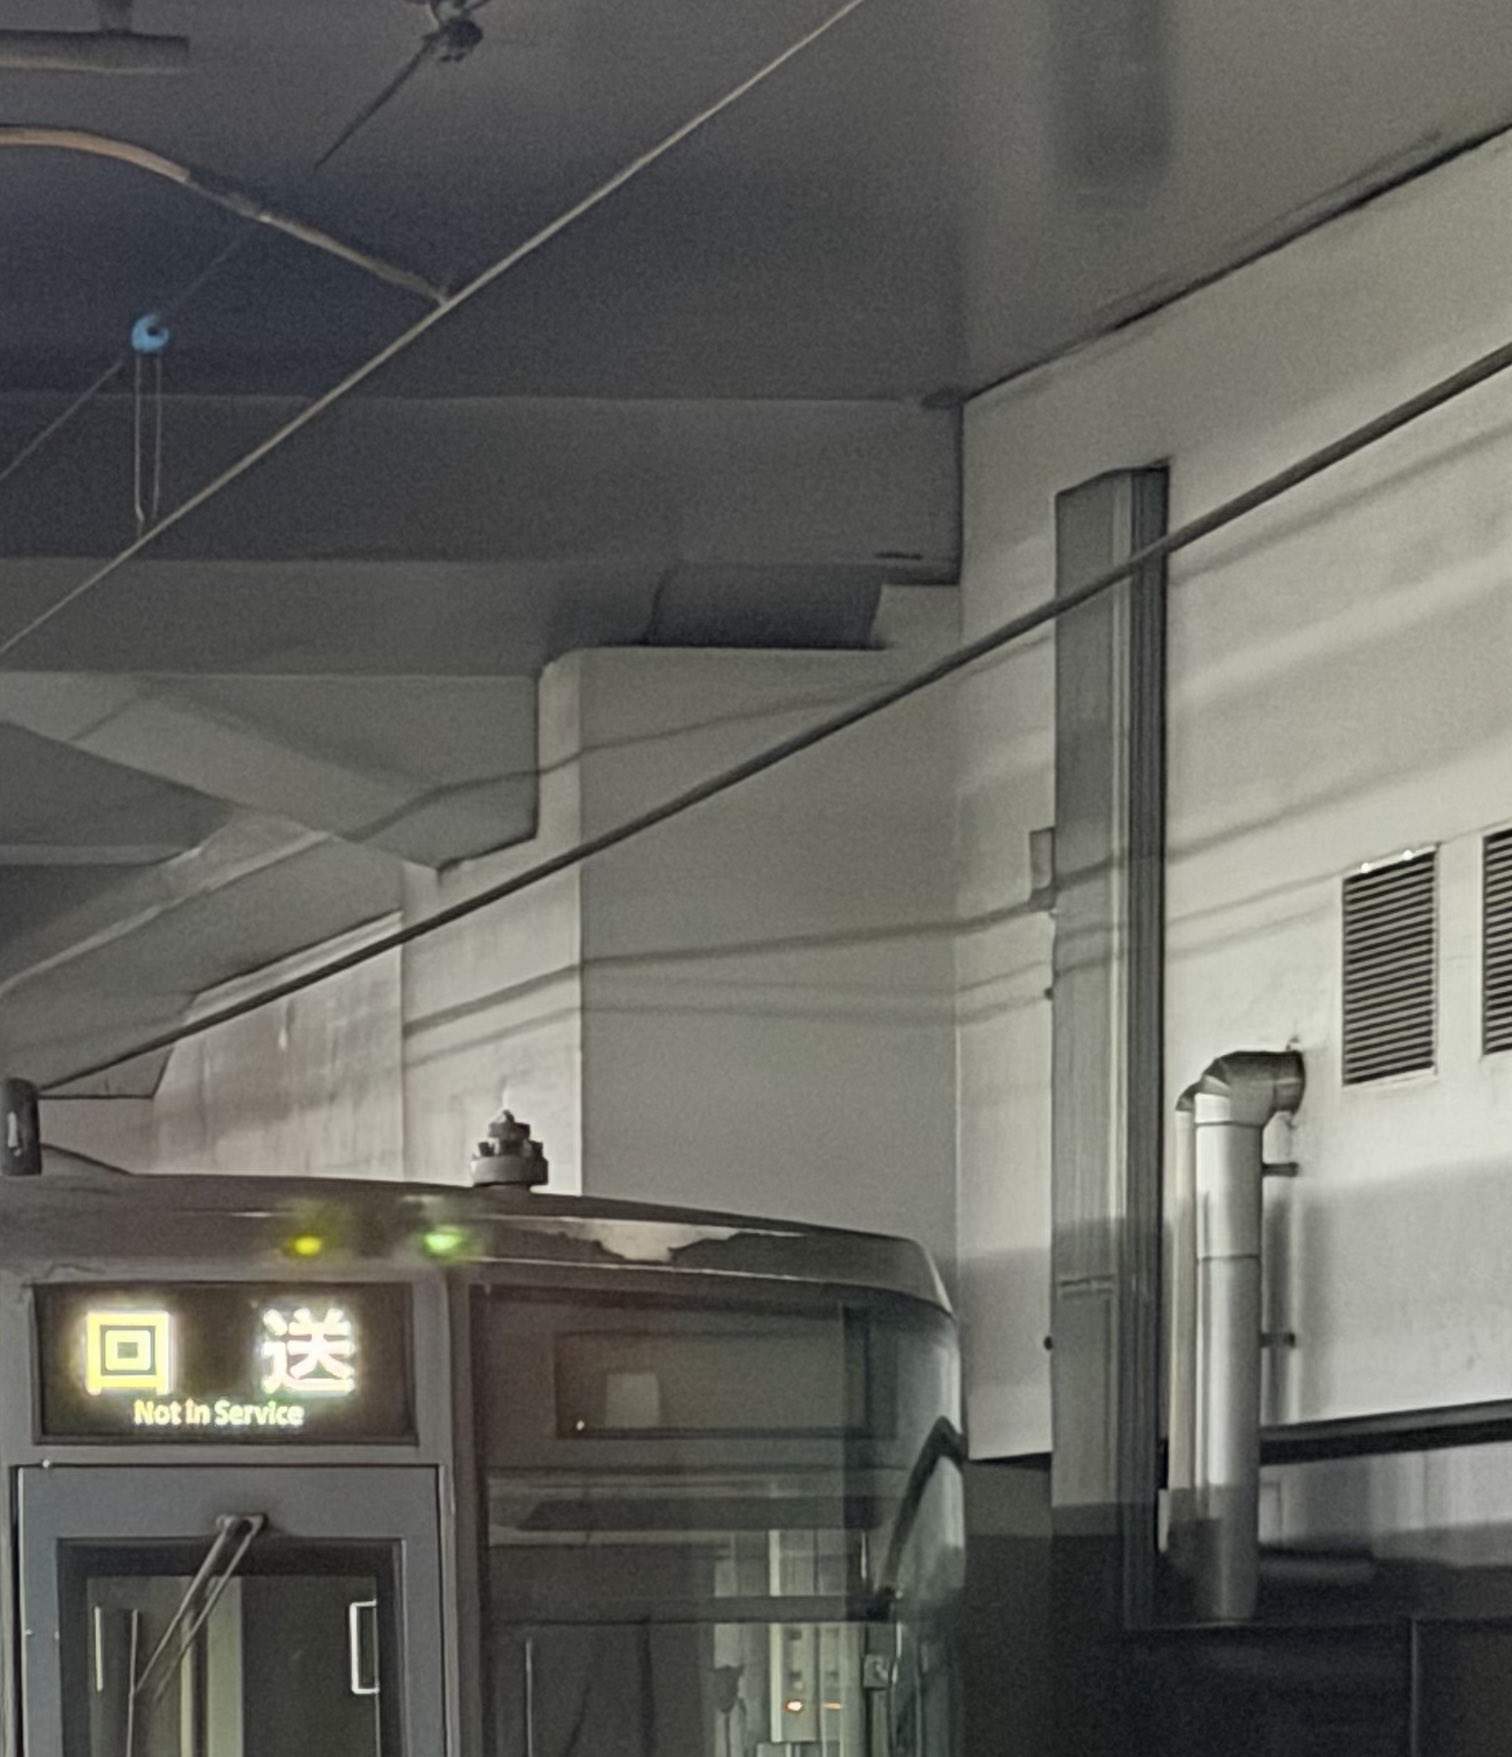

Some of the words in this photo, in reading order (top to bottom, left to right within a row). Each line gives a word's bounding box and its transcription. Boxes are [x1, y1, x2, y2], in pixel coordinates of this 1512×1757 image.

[85, 1307, 357, 1396] 回送
[134, 1399, 182, 1426] Not
[214, 1399, 305, 1426] Service
